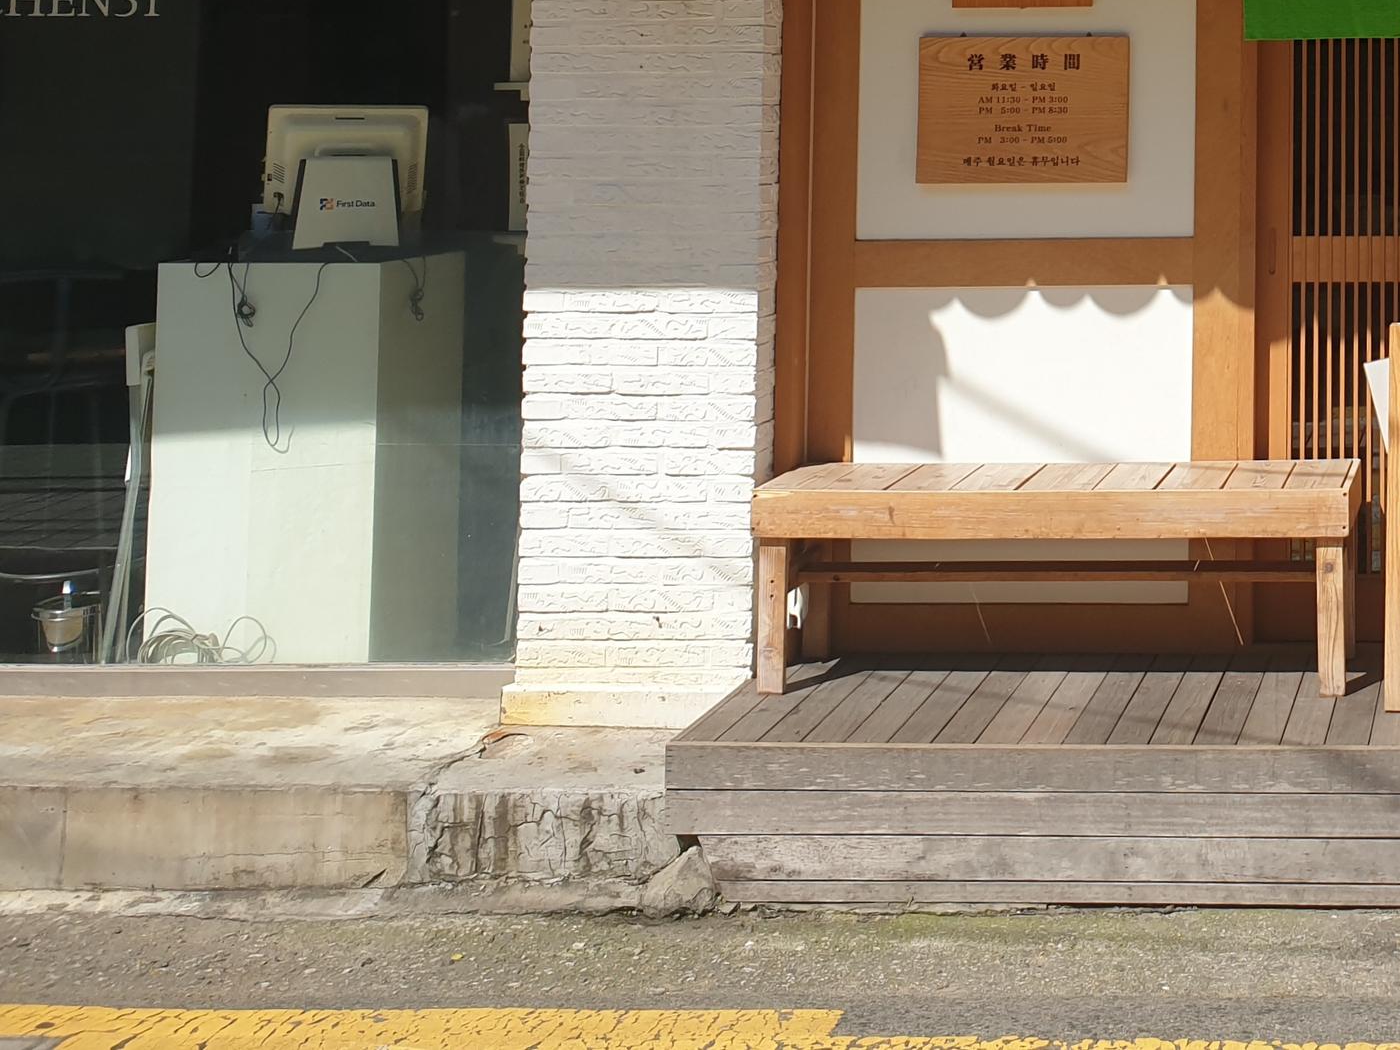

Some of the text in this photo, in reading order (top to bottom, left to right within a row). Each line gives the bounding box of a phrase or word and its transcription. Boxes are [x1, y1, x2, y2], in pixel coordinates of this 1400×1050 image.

[991, 82, 1017, 92] 화요일
[1030, 82, 1056, 92] 일요일
[978, 95, 993, 104] AM
[996, 95, 1021, 104] 11:30
[1032, 95, 1046, 104] PM
[1048, 95, 1069, 104] 3:00
[979, 106, 993, 115] PM
[1032, 106, 1046, 115] PM
[994, 124, 1052, 133] Break Time
[977, 136, 992, 144] PM
[999, 136, 1020, 144] 3:00
[1030, 136, 1045, 144] PM
[986, 156, 1025, 167] 월요일은
[1031, 156, 1081, 167] 휴무입니다
[336, 199, 376, 208] First Data
